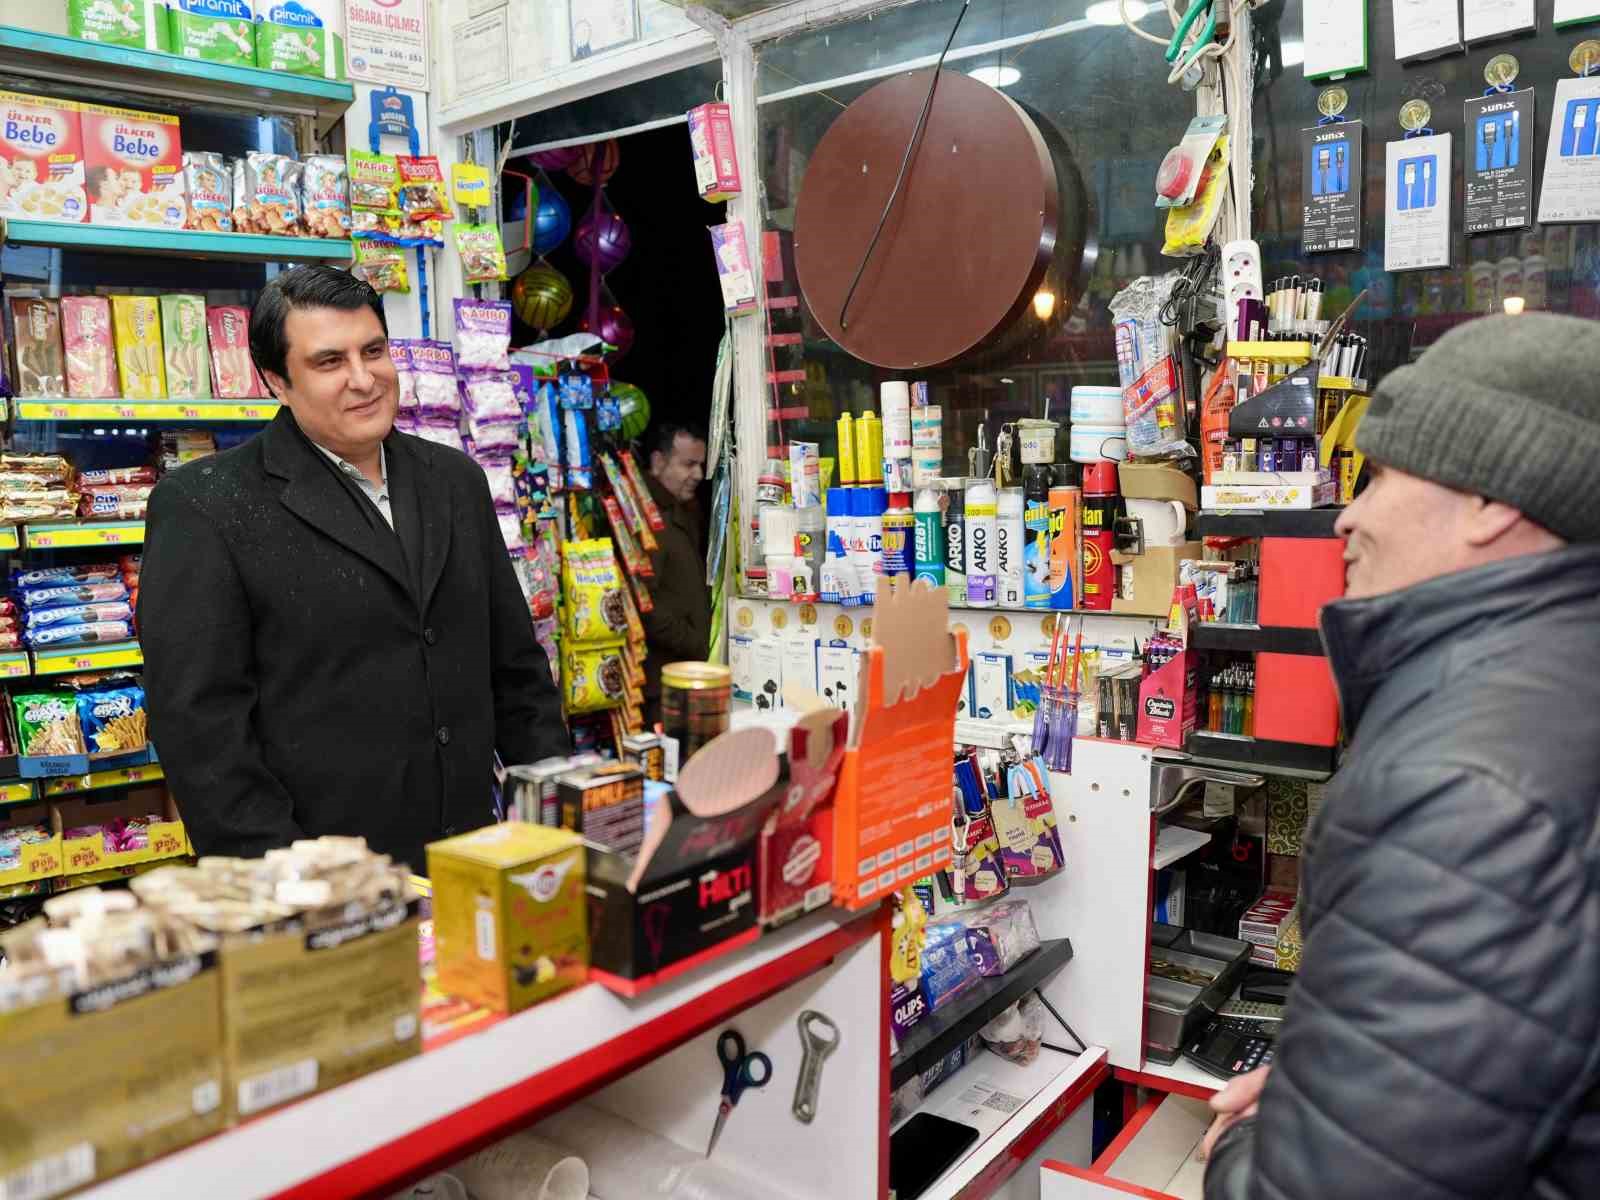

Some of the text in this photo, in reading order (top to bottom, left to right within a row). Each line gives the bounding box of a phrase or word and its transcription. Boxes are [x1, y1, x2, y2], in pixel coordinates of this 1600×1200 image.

[7, 110, 53, 126] ÜLKER
[5, 121, 56, 145] Bebe
[114, 123, 156, 139] ÜLKER
[113, 135, 160, 157] Bebe
[354, 160, 396, 174] HARIB
[461, 308, 506, 322] HARIBO
[915, 519, 927, 562] DERBY
[948, 523, 963, 571] ARKO
[973, 527, 987, 572] ARKO
[998, 528, 1008, 572] ARKO
